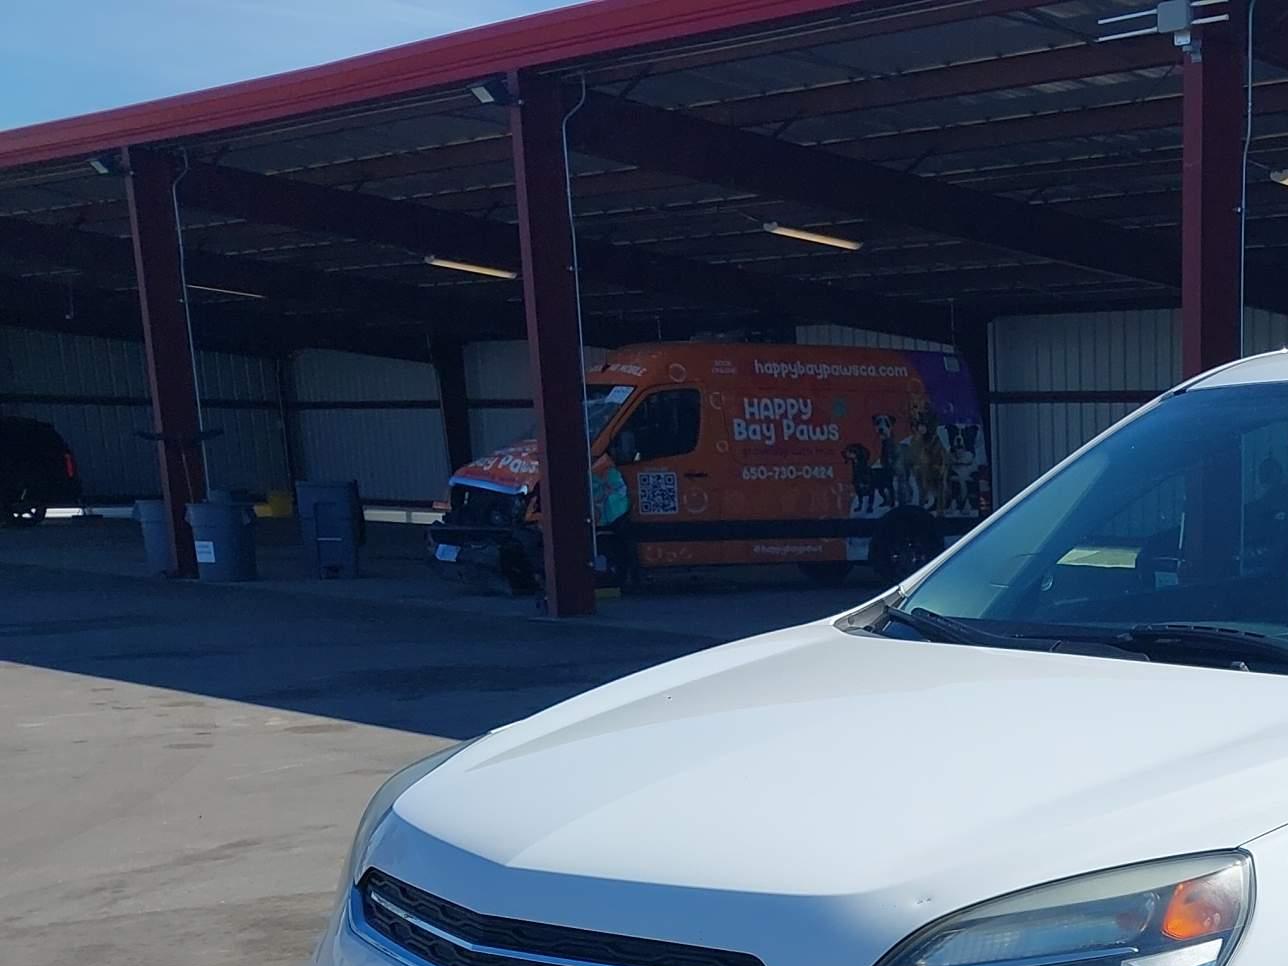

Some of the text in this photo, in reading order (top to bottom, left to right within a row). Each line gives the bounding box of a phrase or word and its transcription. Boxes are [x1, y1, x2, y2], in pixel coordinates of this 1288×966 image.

[754, 360, 908, 379] happybaypawsca.com
[743, 397, 813, 420] HAPPY
[733, 418, 840, 445] Bay Paws
